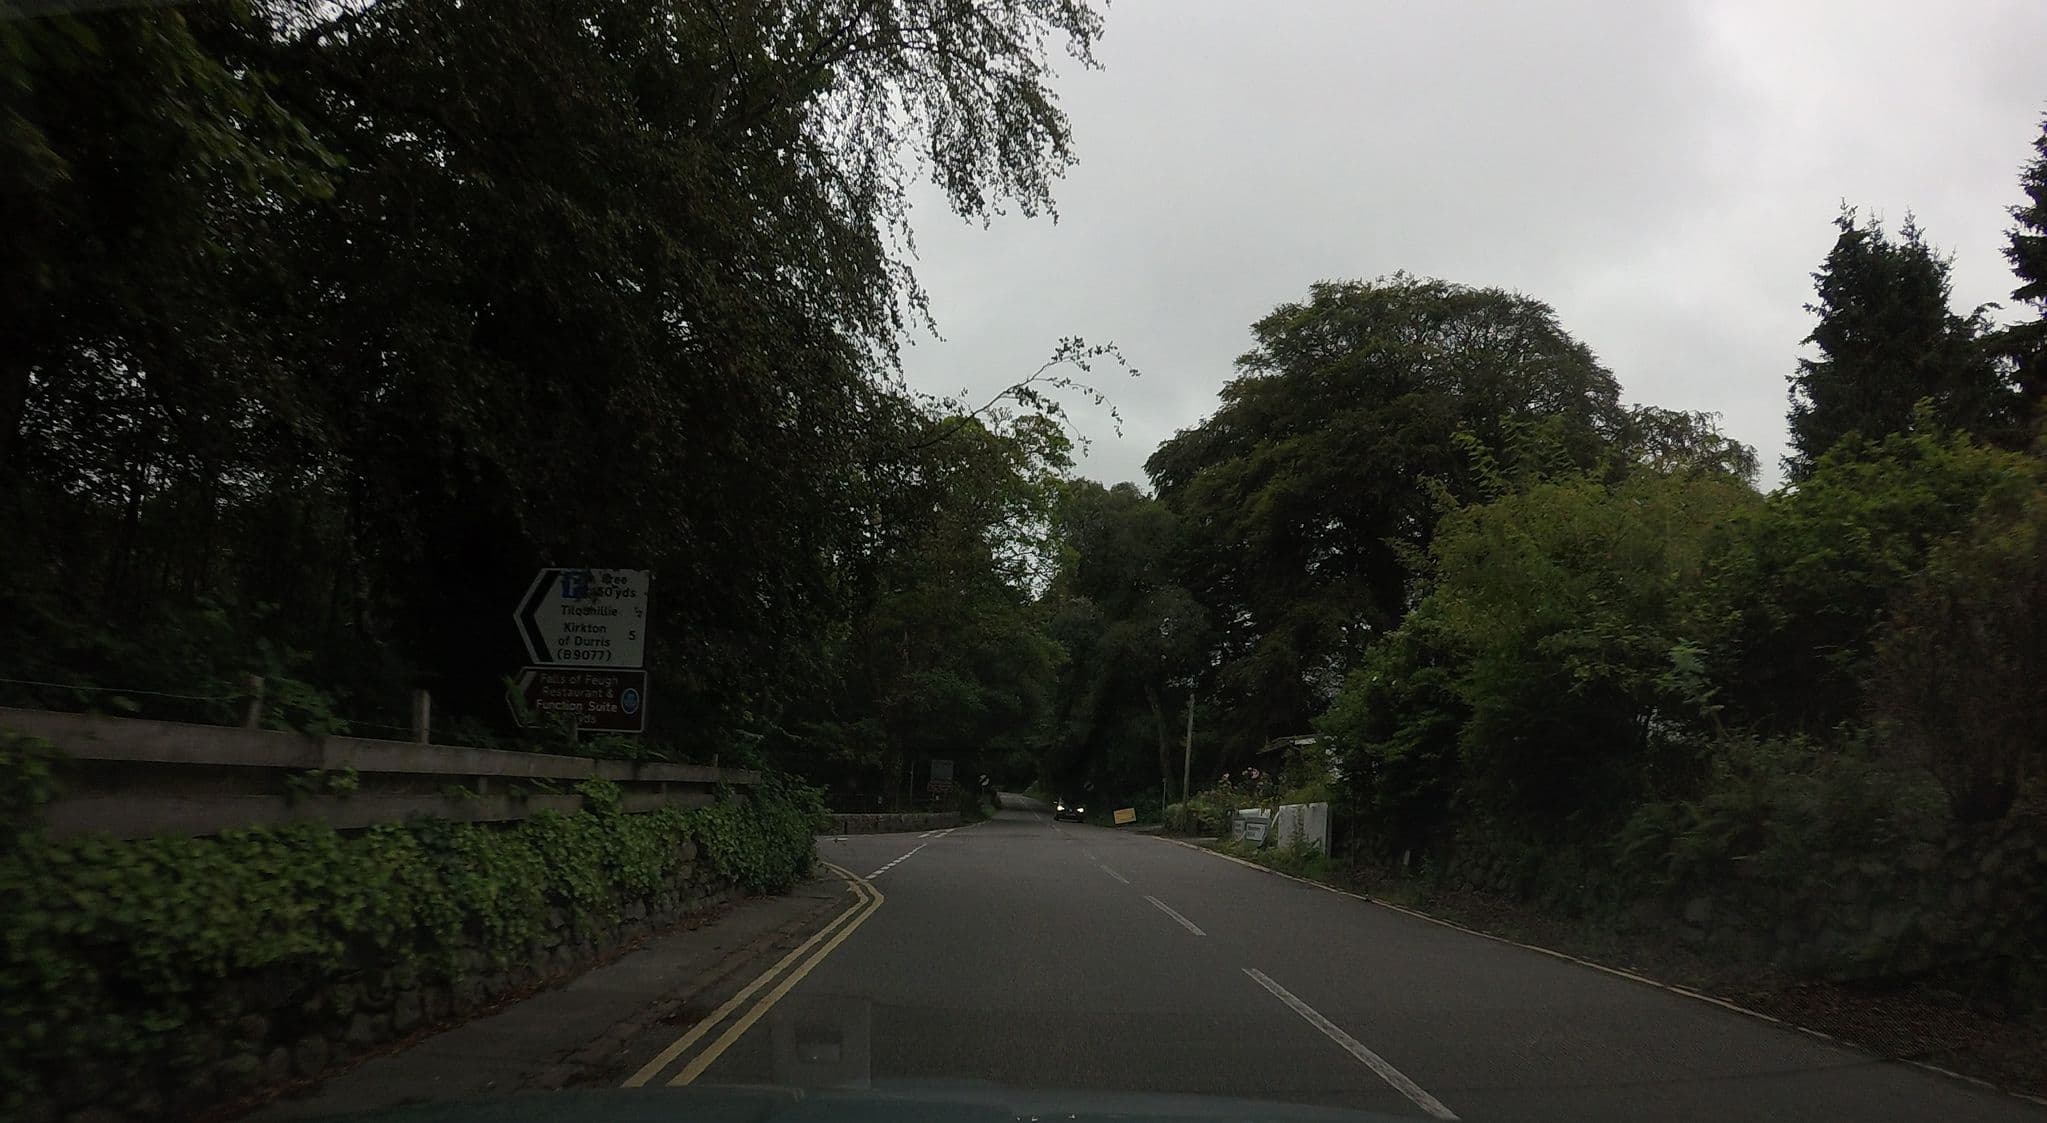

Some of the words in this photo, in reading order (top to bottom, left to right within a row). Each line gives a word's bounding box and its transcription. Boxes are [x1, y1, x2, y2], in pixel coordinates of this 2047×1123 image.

[563, 622, 606, 633] Kirkton
[628, 630, 636, 640] 5
[558, 636, 569, 646] of
[574, 636, 611, 647] Durris
[557, 649, 612, 661] (B9077)
[588, 701, 618, 713] Suite
